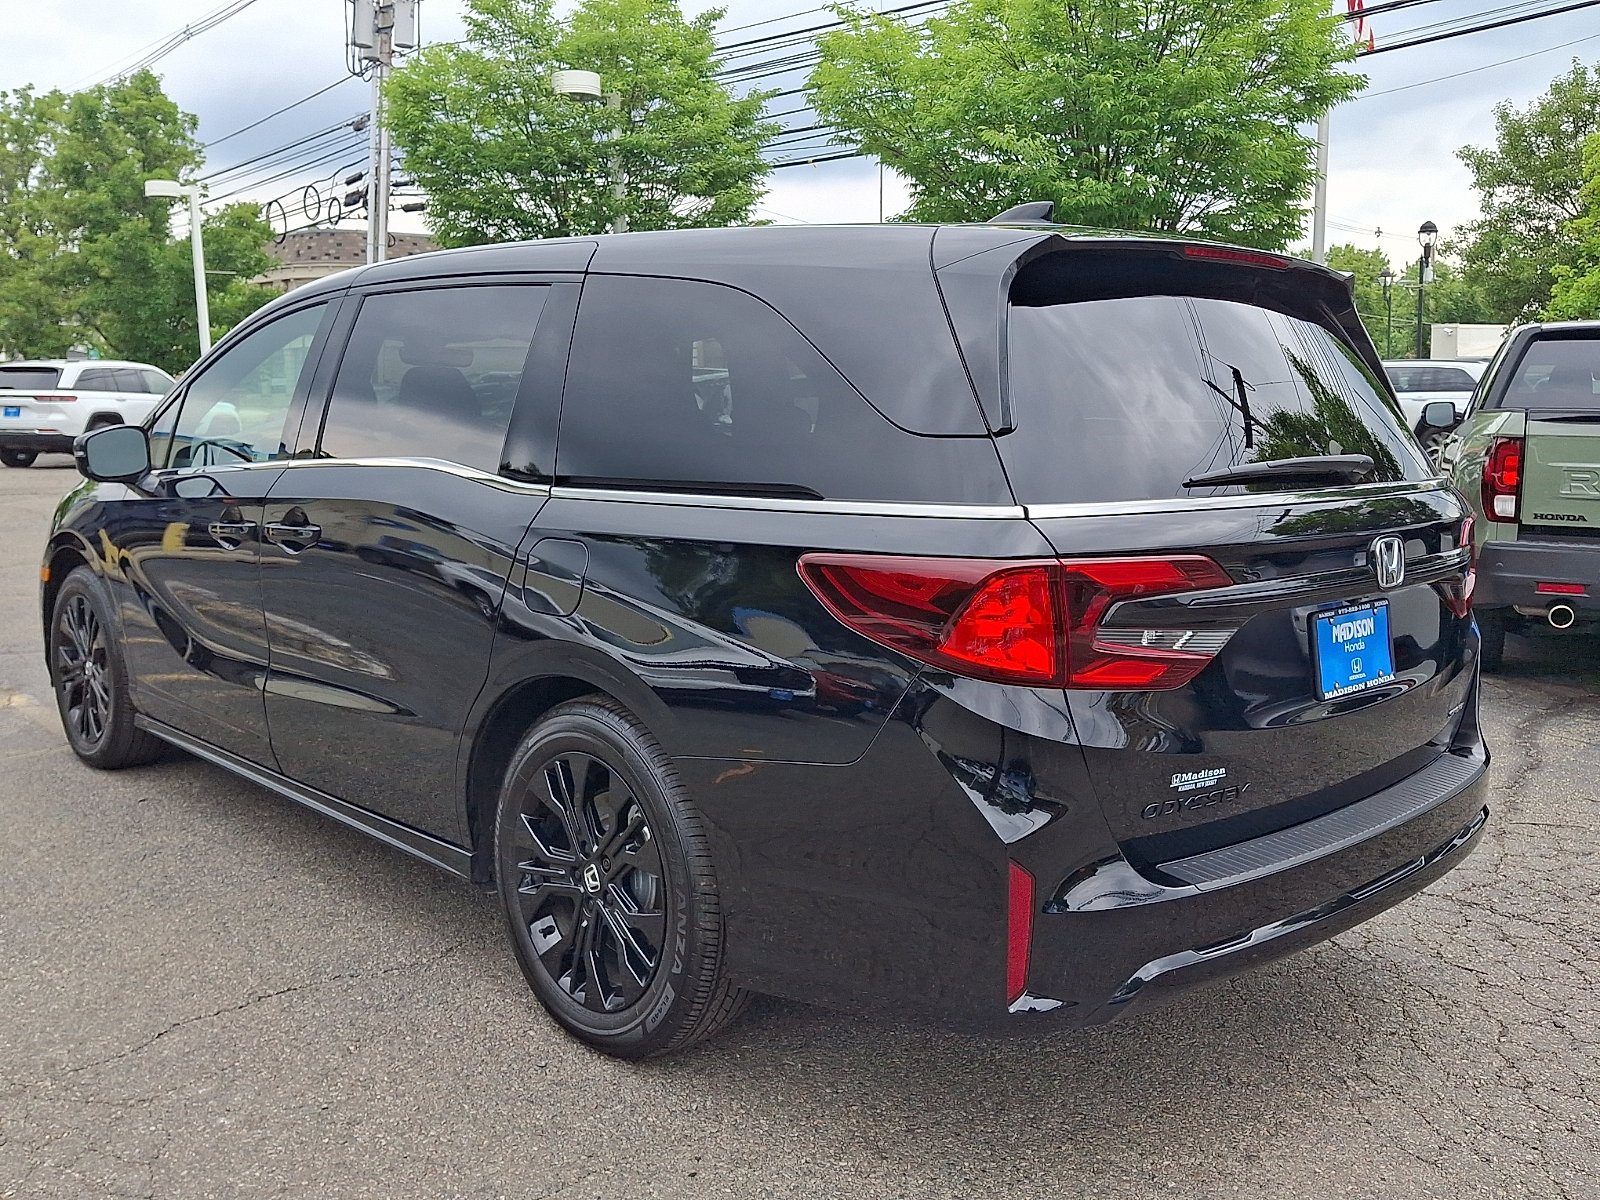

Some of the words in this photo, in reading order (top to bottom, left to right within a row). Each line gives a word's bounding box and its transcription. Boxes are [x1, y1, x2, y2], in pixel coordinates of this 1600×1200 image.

[1533, 513, 1588, 522] HONDA
[1332, 617, 1375, 644] MADISON
[1344, 639, 1366, 653] Honda
[1348, 672, 1367, 681] HONDA
[1324, 684, 1366, 699] MADISON
[1366, 674, 1396, 687] HONDA
[1181, 767, 1226, 782] Madison
[1141, 782, 1252, 819] ODYSSEY
